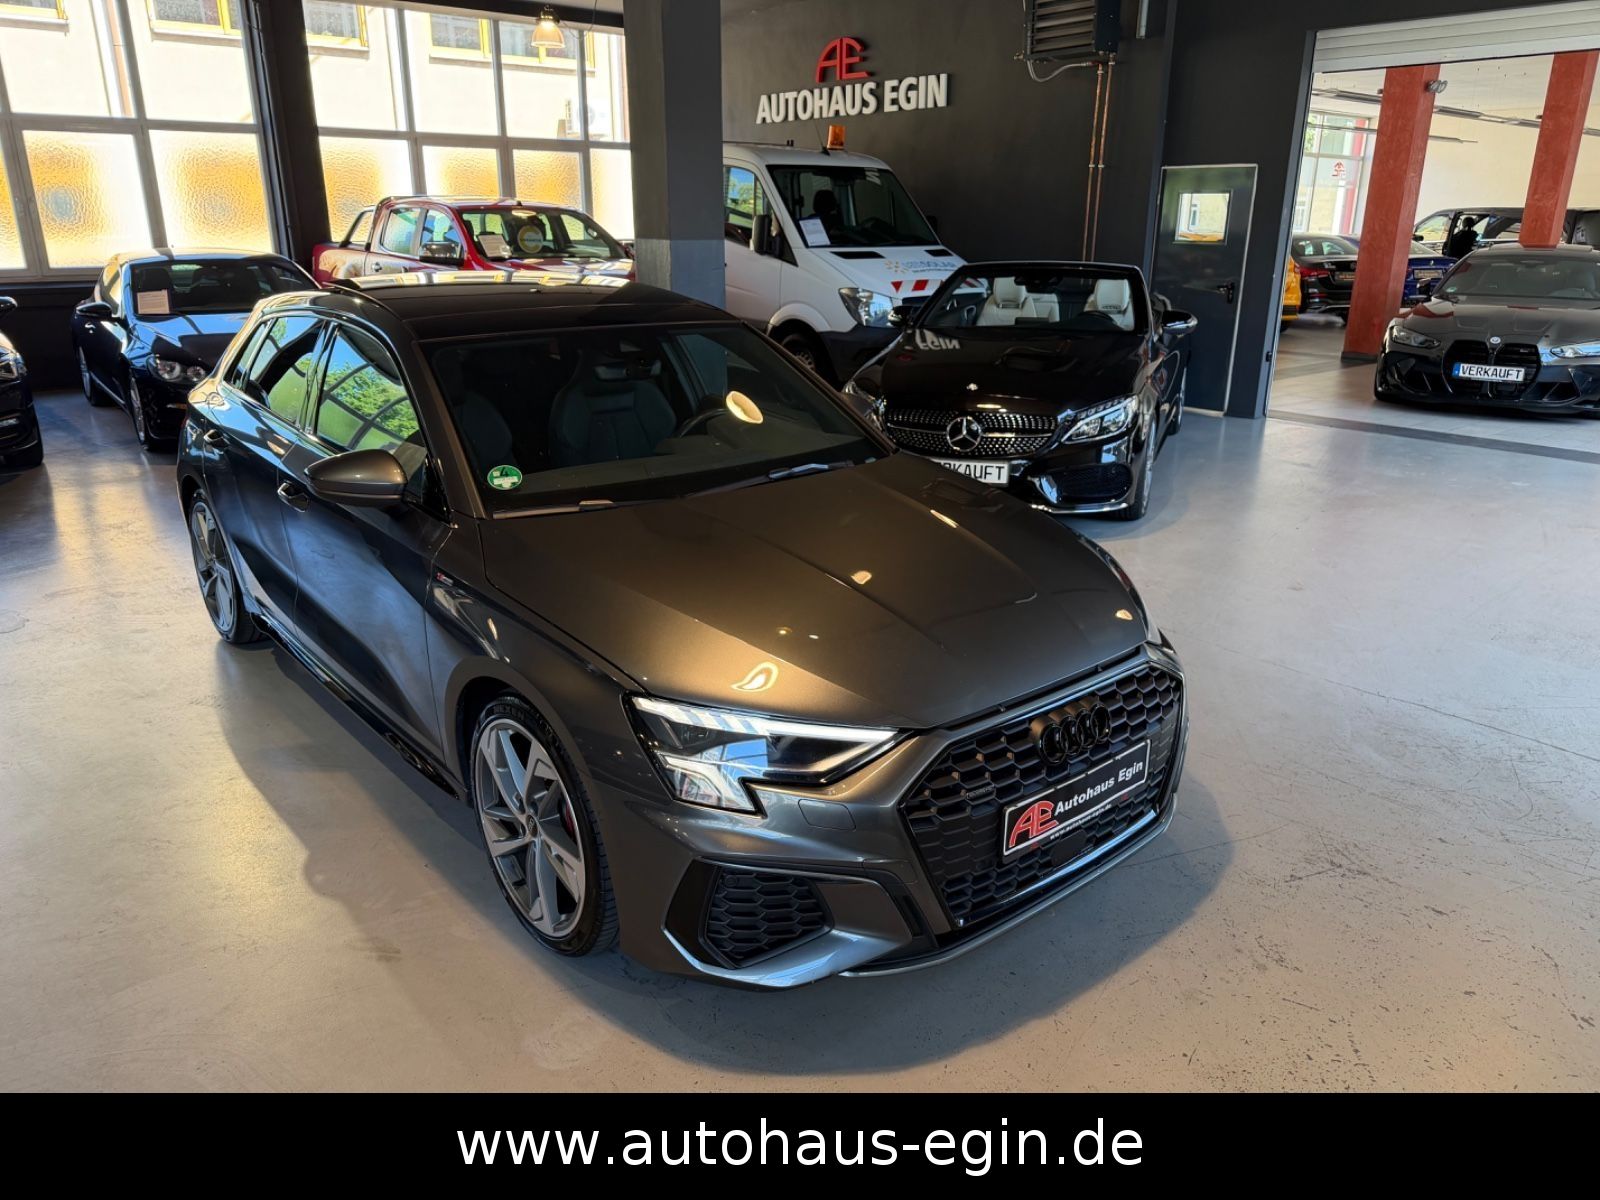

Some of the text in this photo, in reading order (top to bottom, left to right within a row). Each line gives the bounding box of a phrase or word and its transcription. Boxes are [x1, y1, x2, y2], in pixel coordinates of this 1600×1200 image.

[755, 73, 949, 125] AUTOHAUS EGIN
[1461, 365, 1524, 379] VERKAUFT
[1053, 777, 1115, 816] Autohaus
[1117, 761, 1143, 783] Egin
